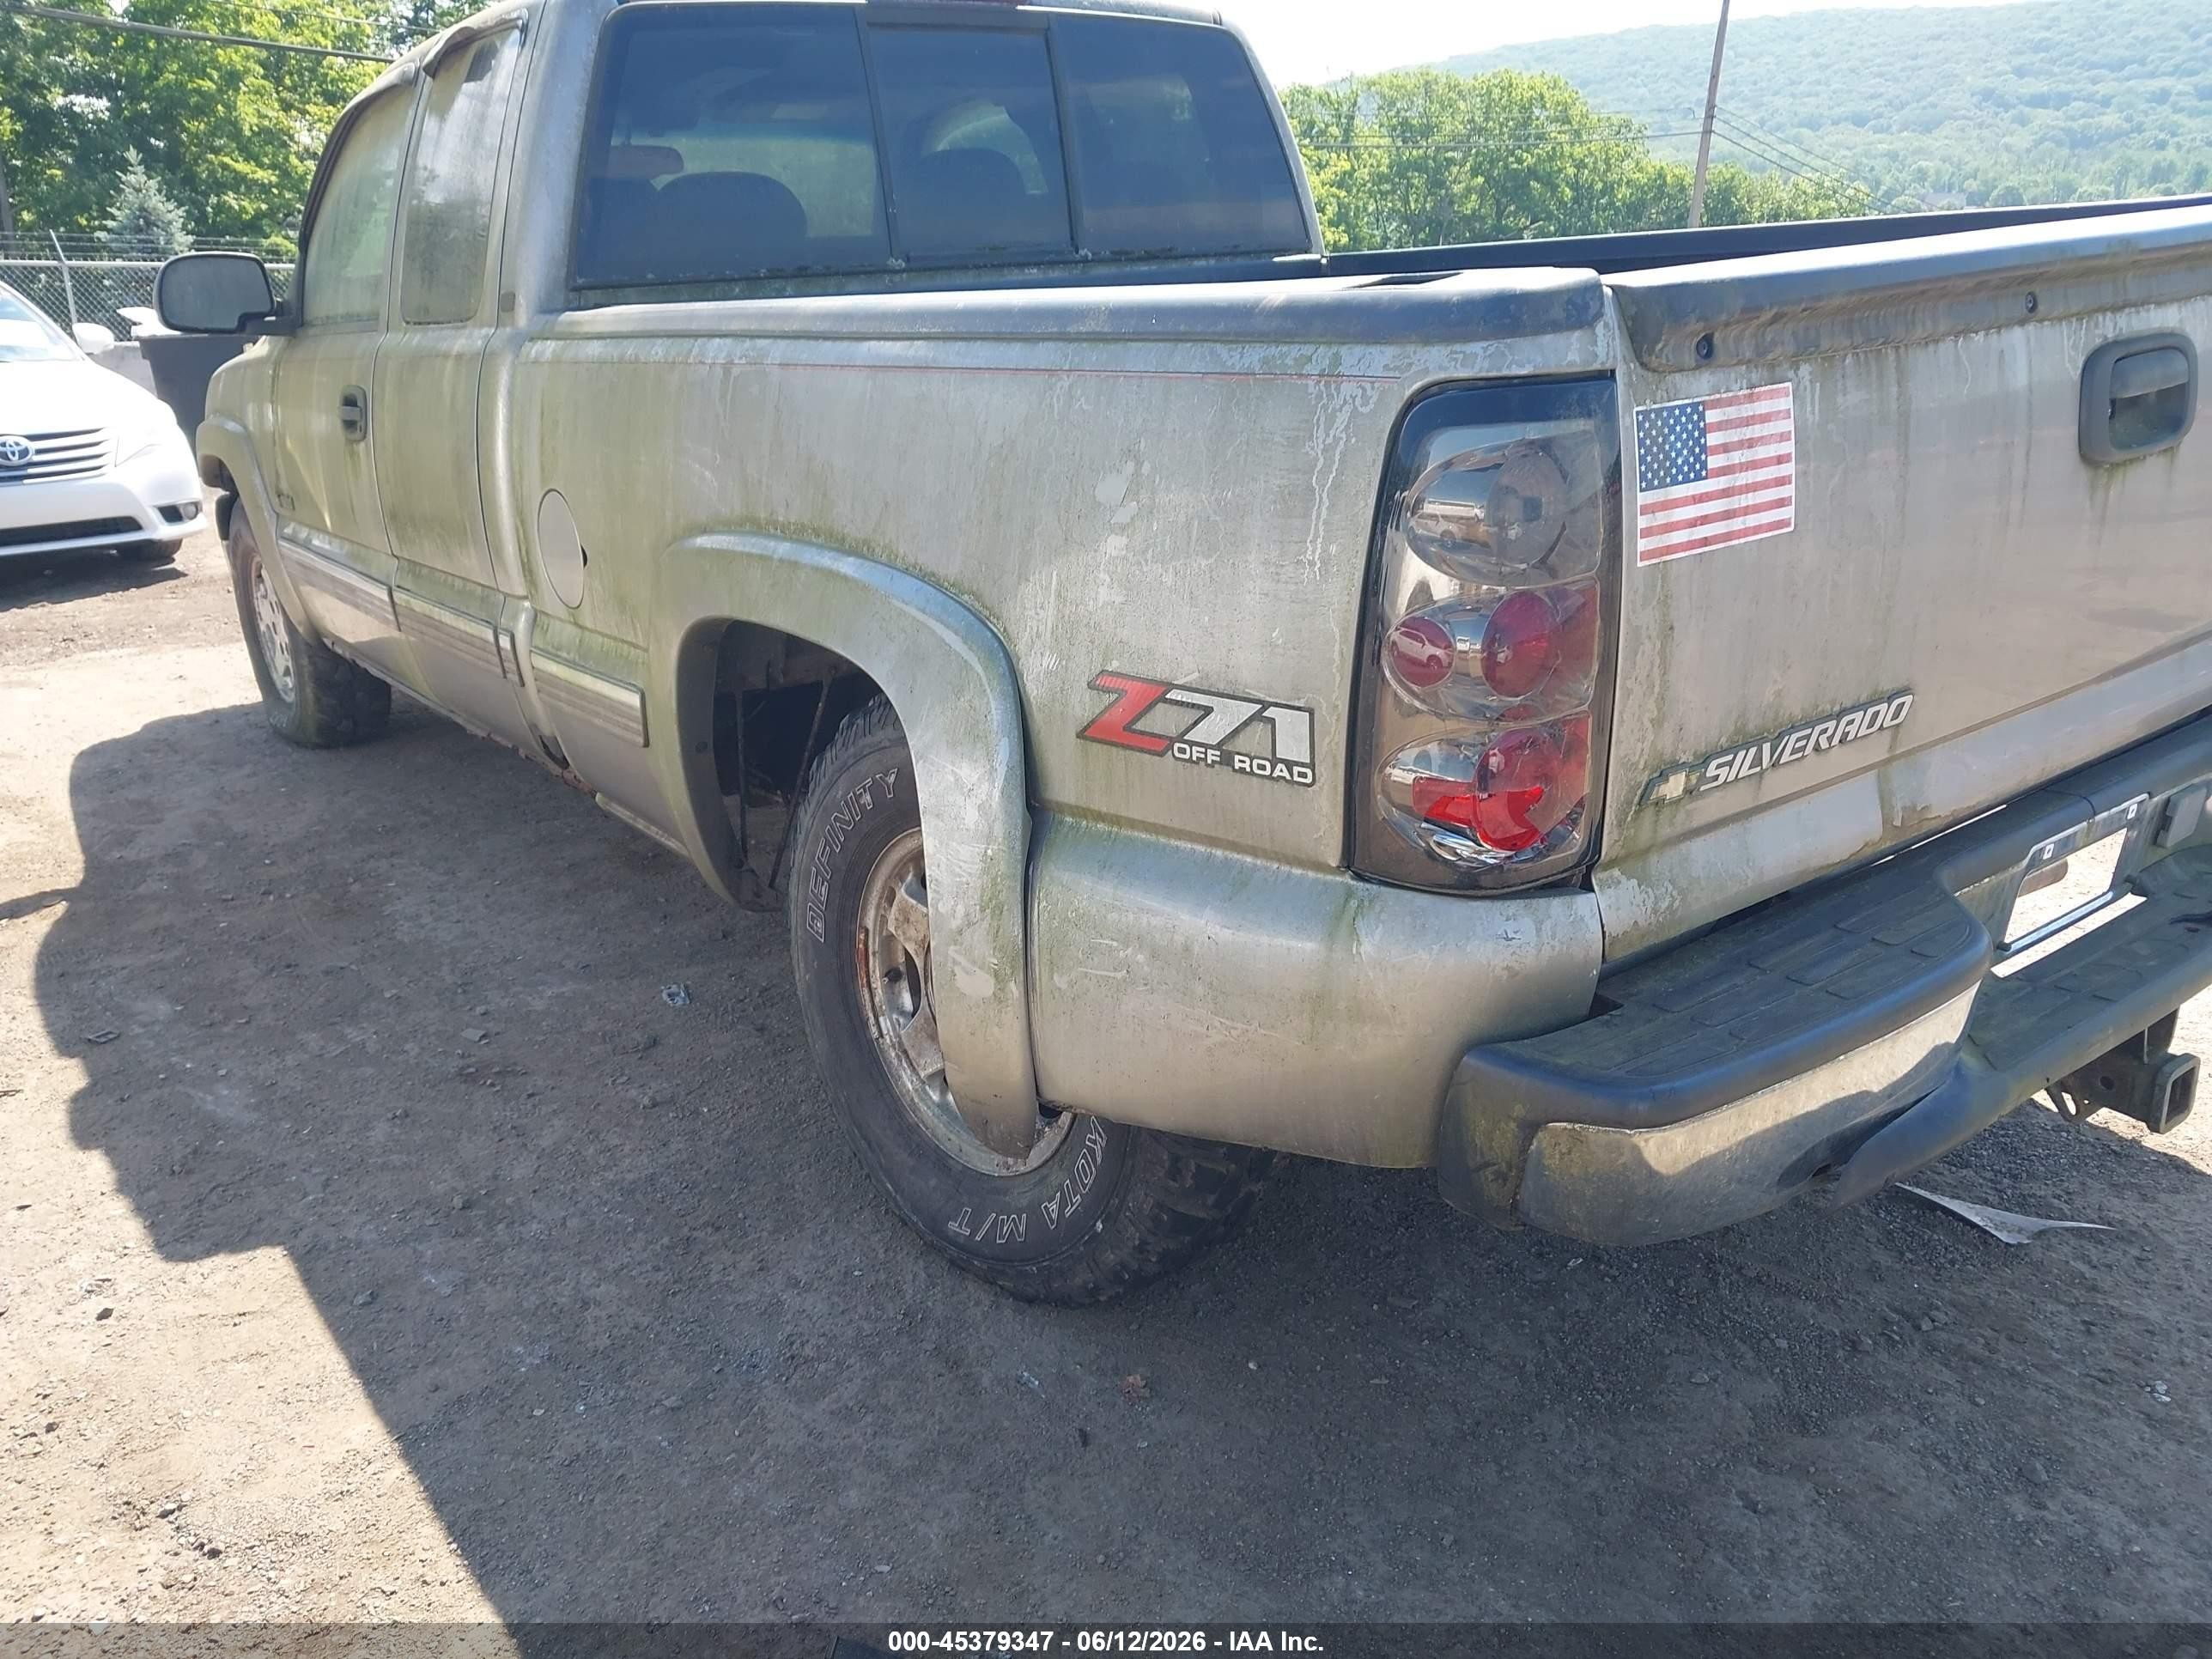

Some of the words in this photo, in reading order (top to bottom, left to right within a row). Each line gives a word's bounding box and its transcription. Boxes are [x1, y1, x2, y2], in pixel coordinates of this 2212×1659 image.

[1078, 671, 1315, 764] Z71
[1173, 742, 1221, 765] OFF
[1234, 754, 1314, 785] ROAD
[1699, 694, 1914, 792] SILVERADO
[806, 768, 898, 944] DEFINITY
[1041, 1115, 1108, 1230] KOTA
[948, 1207, 1027, 1243] M/T
